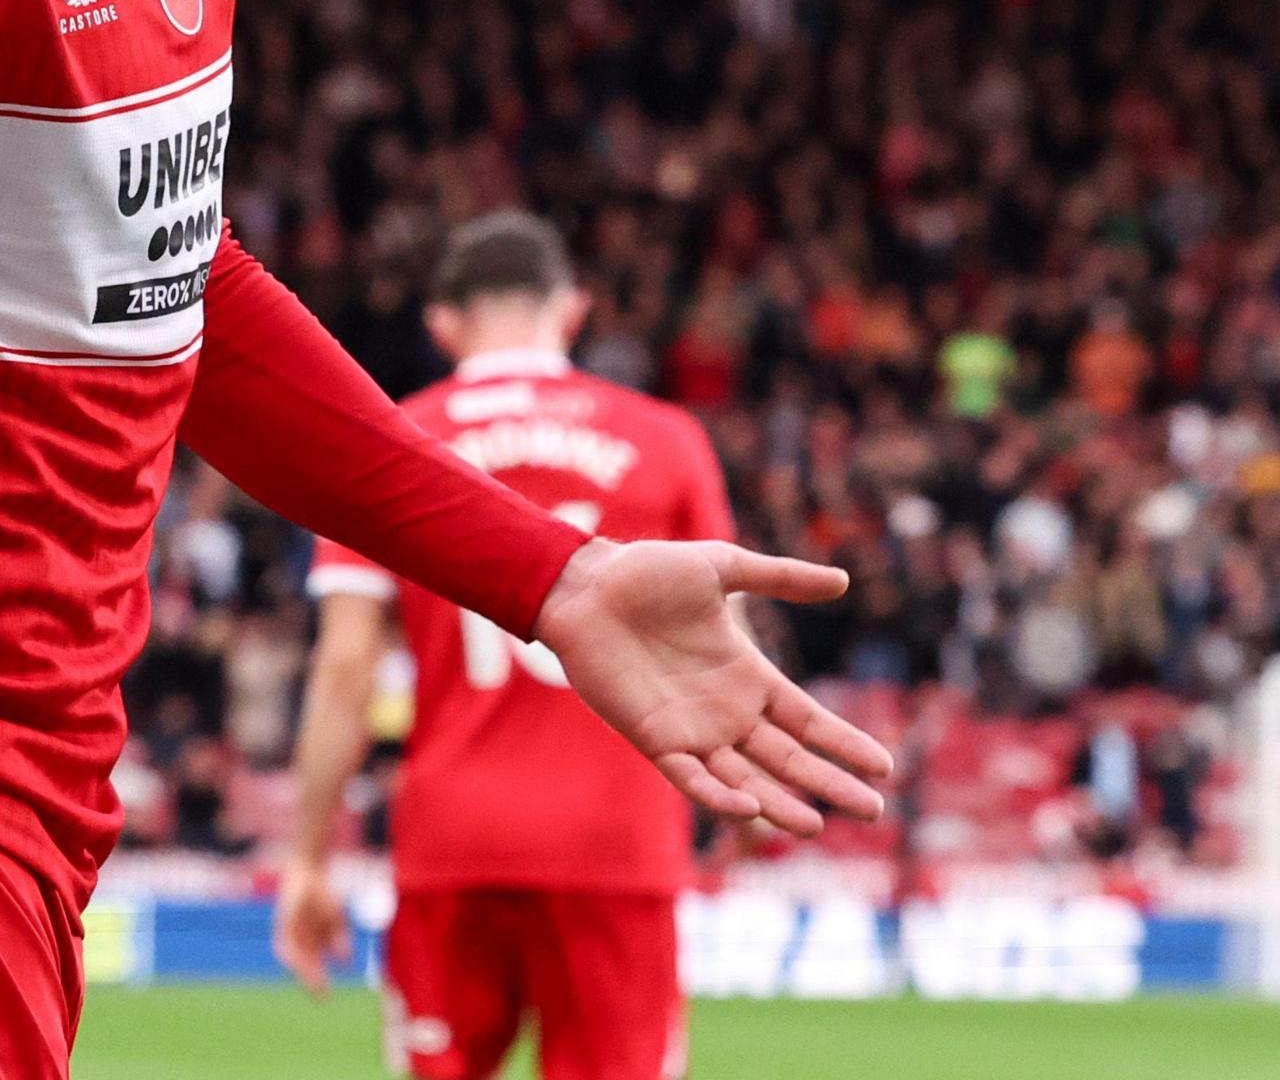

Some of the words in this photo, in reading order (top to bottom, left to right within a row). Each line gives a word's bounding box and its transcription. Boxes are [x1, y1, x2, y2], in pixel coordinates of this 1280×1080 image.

[60, 5, 119, 35] CASTORE
[118, 109, 227, 217] UNIBE
[126, 278, 192, 314] ZERO%
